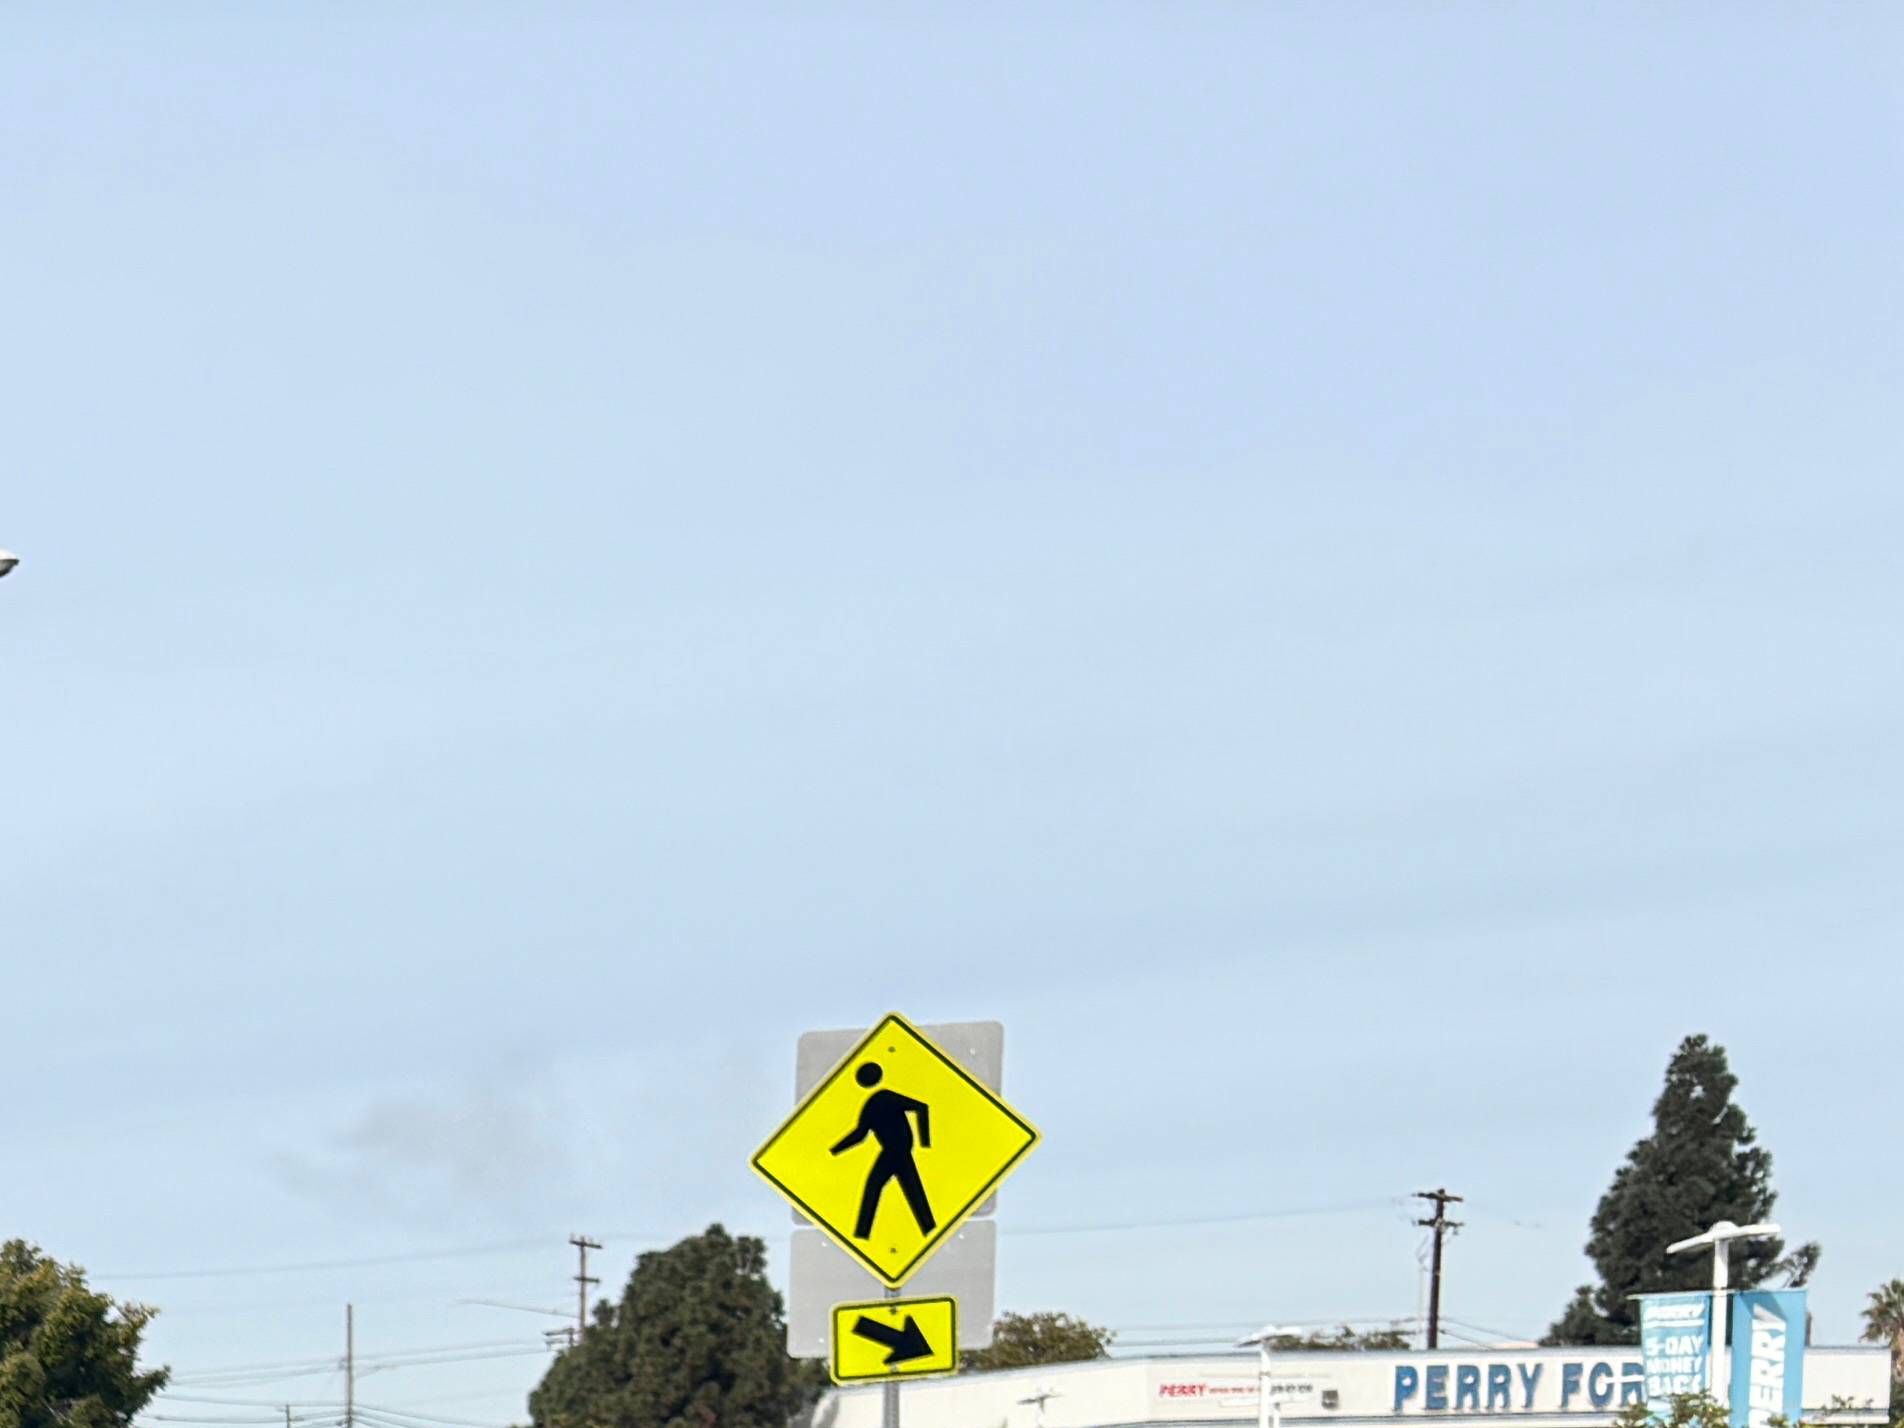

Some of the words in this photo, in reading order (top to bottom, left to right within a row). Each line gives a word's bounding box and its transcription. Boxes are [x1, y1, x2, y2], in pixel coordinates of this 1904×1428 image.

[1646, 1335, 1704, 1356] 5-DAY
[1646, 1357, 1703, 1375] MONEY
[1393, 1362, 1543, 1409] PERRY
[1648, 1375, 1703, 1397] BACK
